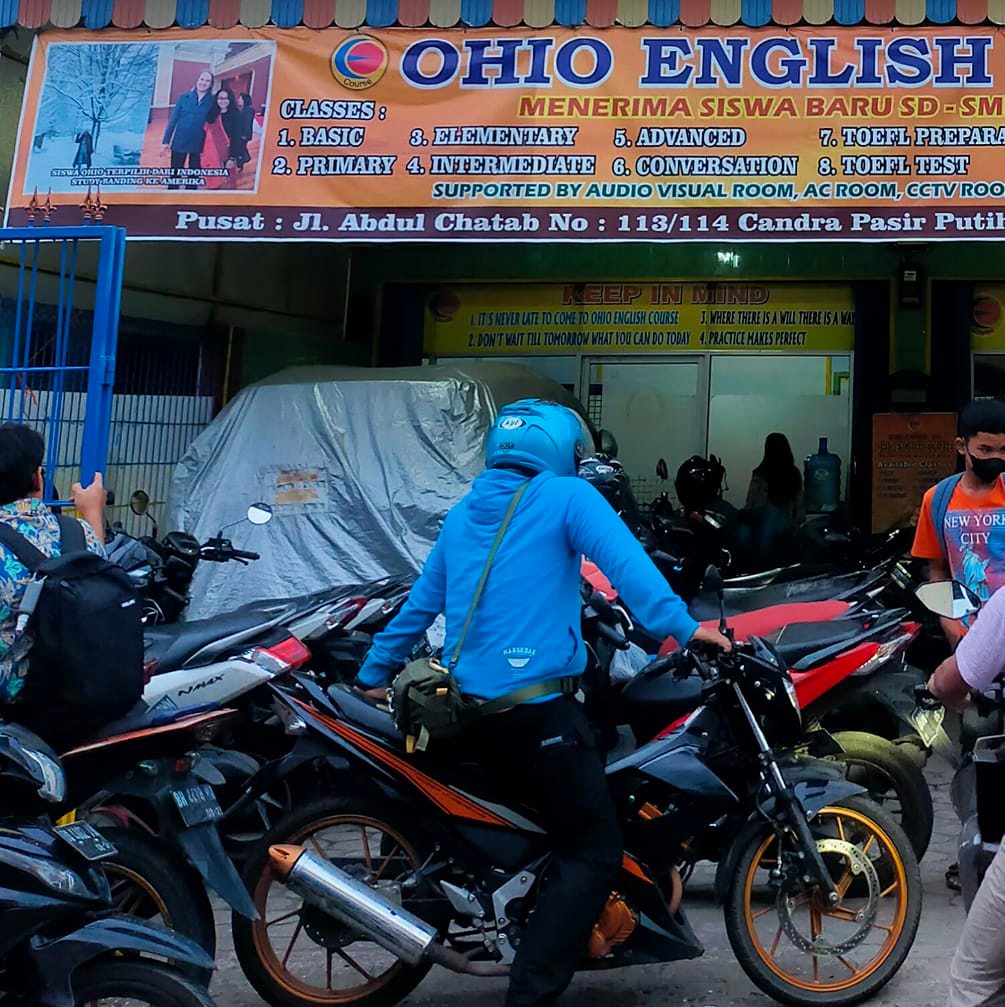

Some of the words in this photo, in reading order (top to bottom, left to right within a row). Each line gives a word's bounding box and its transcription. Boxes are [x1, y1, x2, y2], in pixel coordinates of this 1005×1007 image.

[400, 36, 615, 90] OHIO
[638, 36, 995, 90] ENGLISH
[279, 99, 374, 120] CLASSES
[518, 96, 692, 119] MENERIMA
[698, 96, 802, 119] SISWA
[805, 95, 892, 119] BARU
[898, 95, 939, 119] SD
[298, 127, 365, 147] BASIC
[431, 126, 579, 147] ELEMENTARY
[635, 127, 747, 148] ADVANCED
[840, 126, 909, 147] TOEFL
[174, 167, 230, 177] INDONESIA
[295, 156, 397, 176] PRIMARY
[428, 155, 597, 176] INTERMEDIATE
[634, 155, 799, 176] CONVERSATION
[840, 155, 910, 176] TOEFL
[914, 155, 970, 176] TEST
[431, 181, 552, 200] SUPPORTED
[554, 181, 583, 200] BY
[585, 181, 654, 200] AUDIO
[655, 181, 728, 200] VISUAL
[735, 181, 799, 200] ROOM,
[800, 181, 834, 200] AC
[835, 181, 900, 200] ROOM,
[905, 181, 959, 200] CCTV
[175, 210, 264, 231] Pusat
[293, 212, 329, 232] Jl.
[338, 211, 426, 232] Abdul
[433, 211, 540, 232] Chatab
[548, 212, 589, 232] No
[617, 212, 729, 233] 113/114
[737, 211, 842, 232] Candra
[849, 211, 927, 232] Pasir
[561, 283, 642, 306] KEEP
[650, 284, 683, 306] IN
[691, 284, 770, 306] MIND
[554, 311, 577, 326] COME
[591, 311, 611, 326] OHIO
[613, 311, 646, 325] ENGLISH
[648, 311, 680, 325] COURSE
[710, 311, 736, 325] WHERE
[738, 311, 761, 325] THERE
[762, 311, 770, 325] IS
[779, 311, 796, 325] WILL
[799, 311, 822, 325] THERE
[823, 311, 831, 325] IS
[527, 332, 541, 346] TILL
[543, 331, 589, 346] TOMORROW
[591, 331, 614, 346] WHAT
[615, 331, 631, 346] YOU
[633, 331, 650, 346] CAN
[652, 331, 664, 346] DO
[666, 331, 692, 346] TODAY
[708, 331, 745, 346] PRACTICE
[748, 331, 774, 346] MAKES
[775, 331, 808, 345] PERFECT
[944, 514, 970, 529] NEW
[960, 532, 991, 545] CITY
